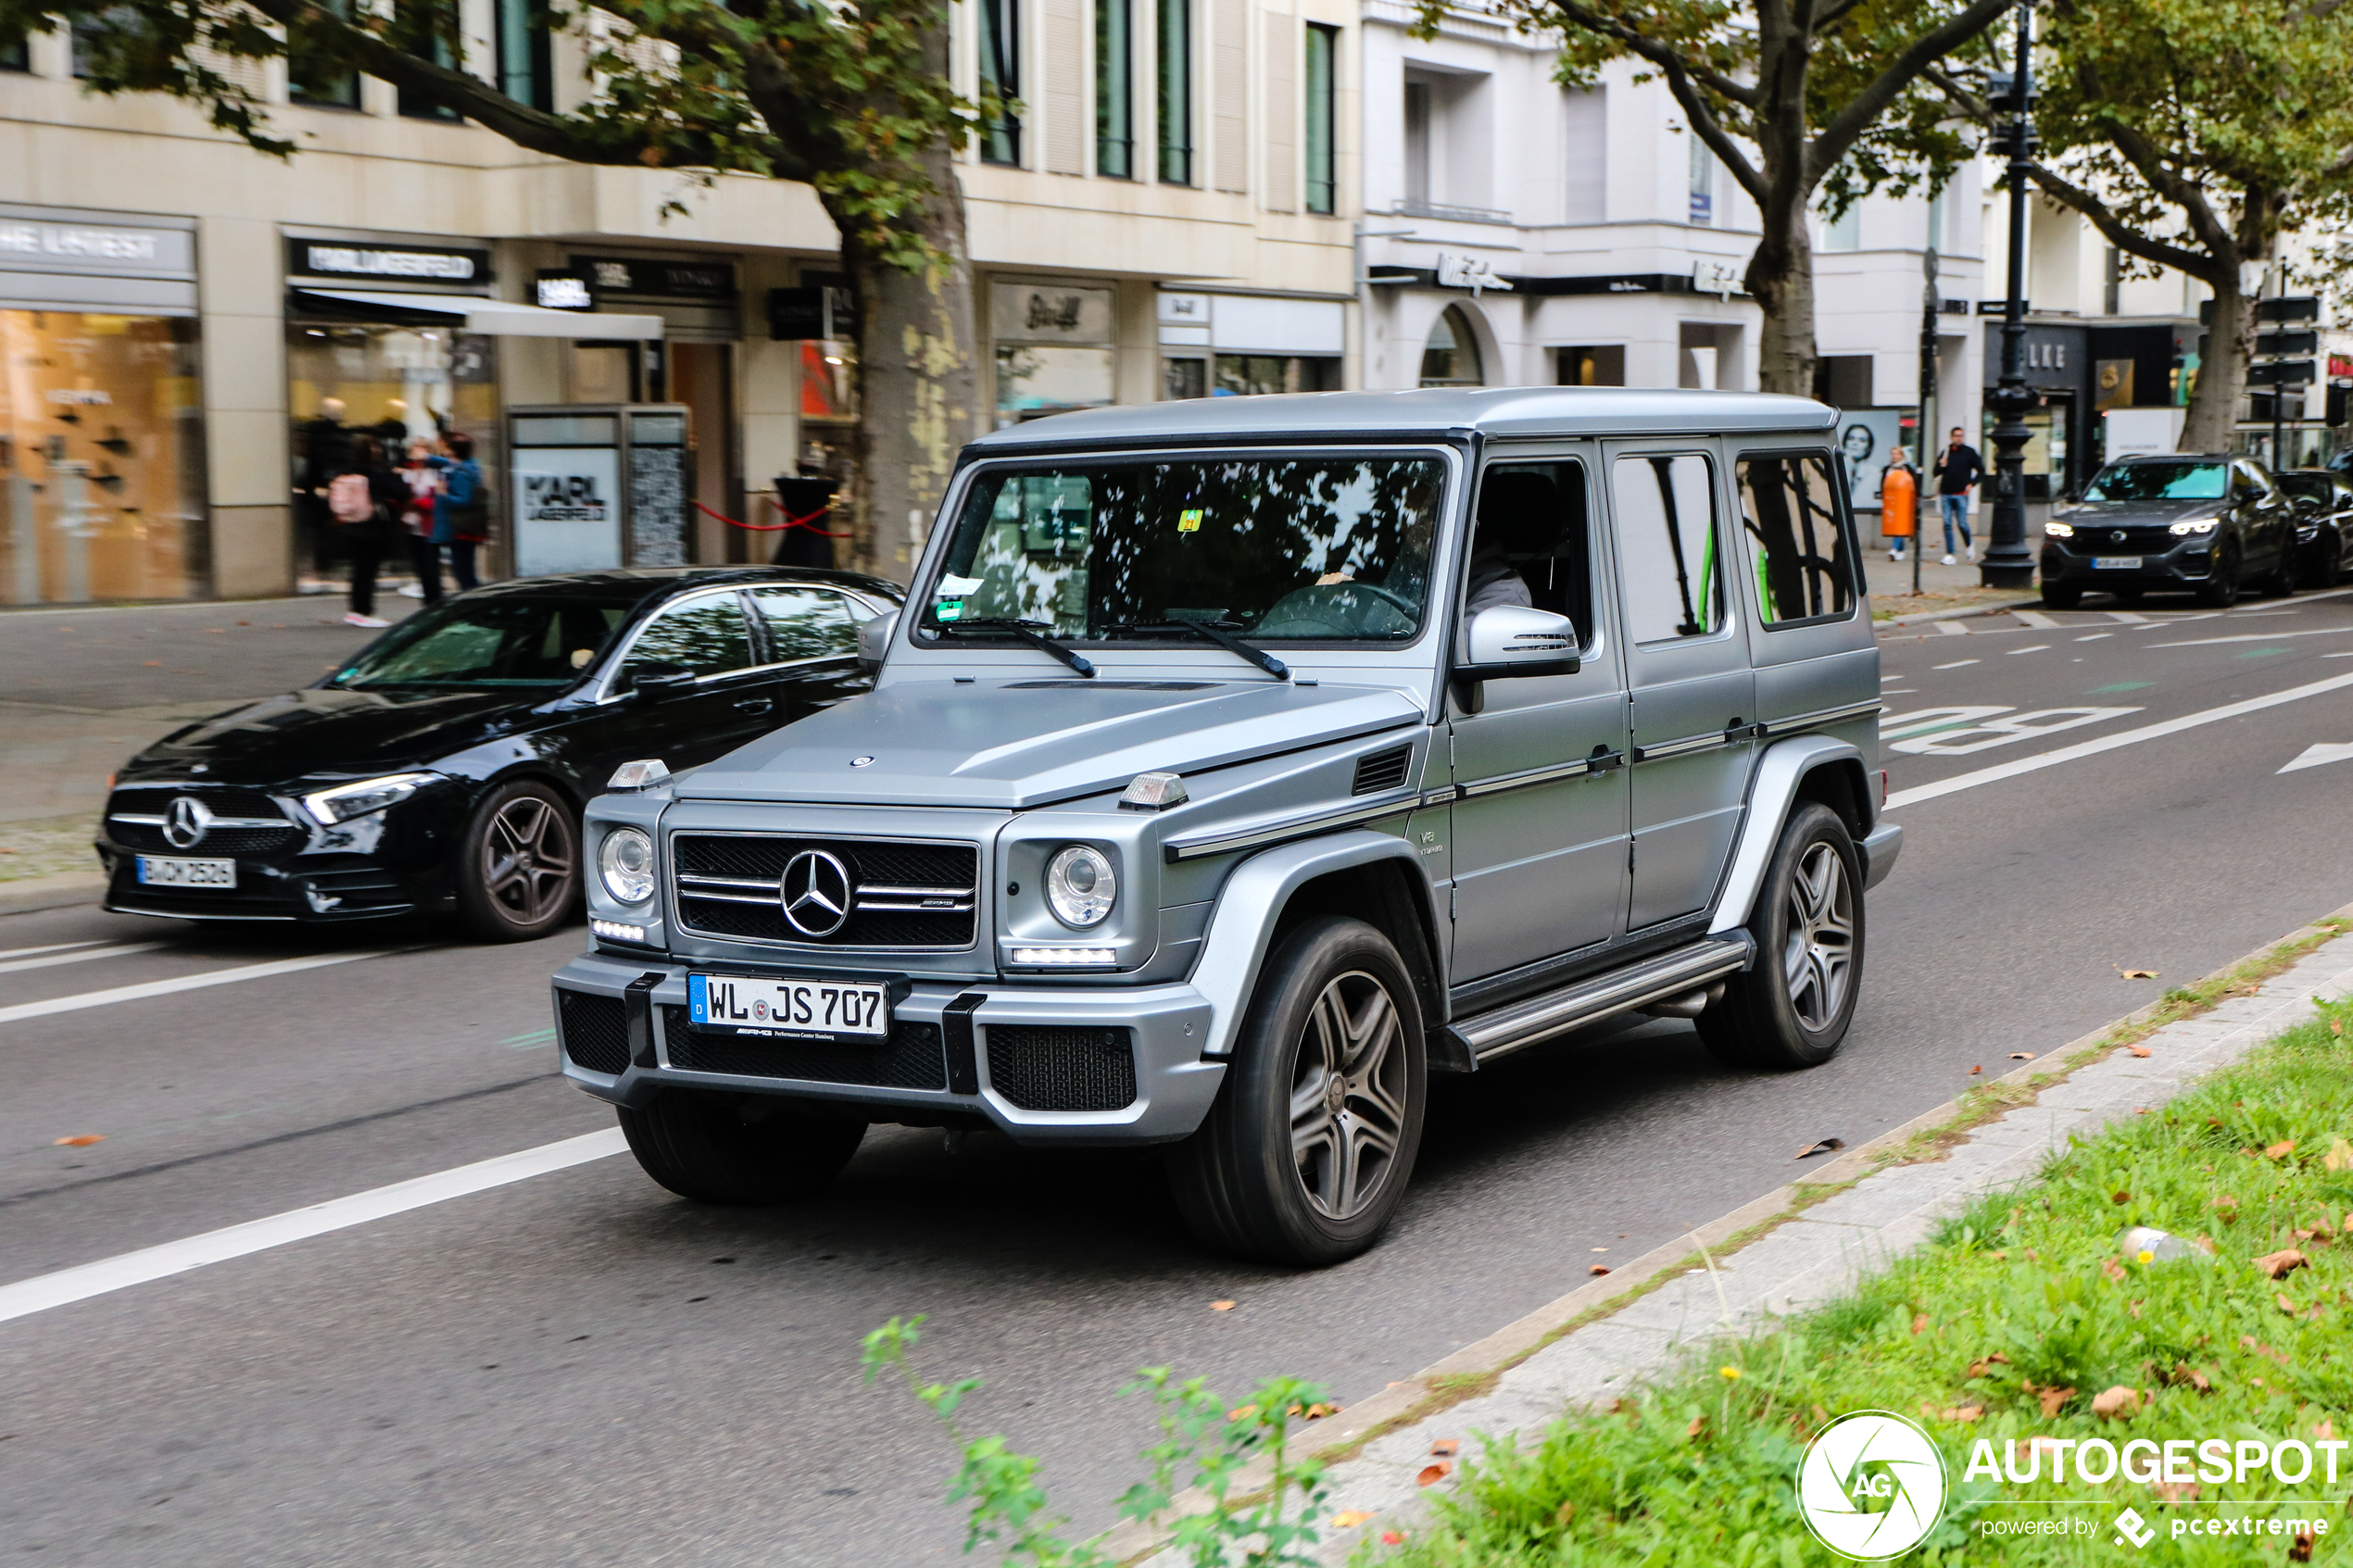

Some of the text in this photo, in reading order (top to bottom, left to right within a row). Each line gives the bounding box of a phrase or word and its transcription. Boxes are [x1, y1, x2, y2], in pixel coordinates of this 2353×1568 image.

[2029, 344, 2065, 368] LKE
[1420, 831, 1434, 844] V8
[697, 1004, 703, 1015] D
[709, 982, 881, 1028] WL JS 707
[815, 1033, 835, 1041] Hamburg
